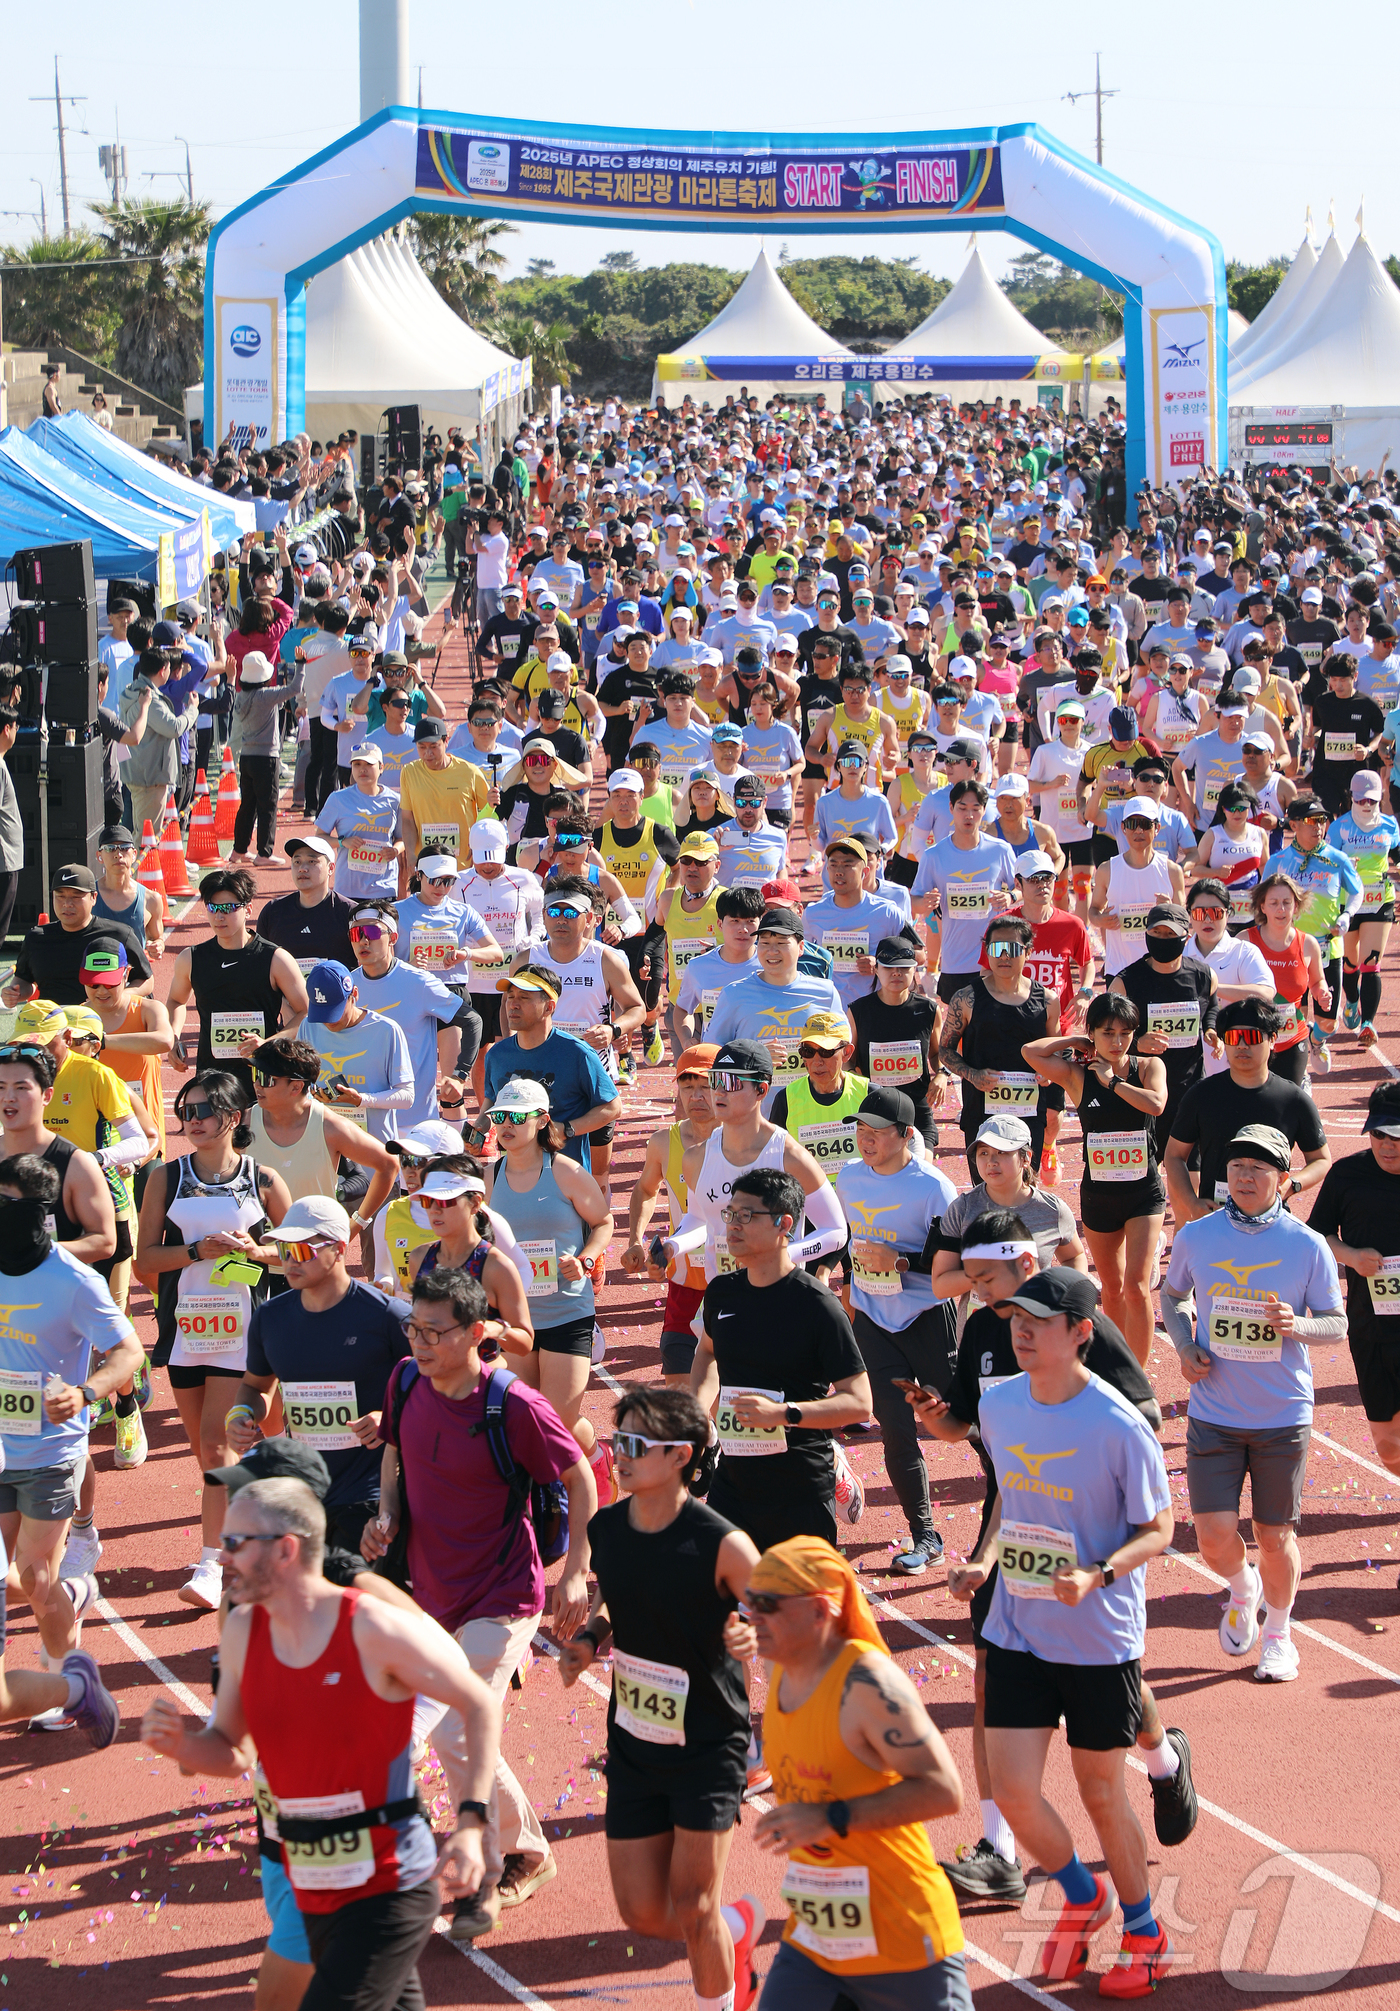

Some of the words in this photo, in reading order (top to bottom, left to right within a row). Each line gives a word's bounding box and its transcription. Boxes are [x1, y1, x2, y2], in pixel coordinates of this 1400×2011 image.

[521, 146, 574, 166] 2025년
[576, 151, 624, 169] APEC
[627, 155, 683, 172] 정상회의
[686, 158, 742, 175] 제주유치
[746, 160, 777, 175] 기원!
[519, 164, 553, 181] 제28회
[533, 183, 552, 194] 1995
[554, 169, 673, 204] 제주국제관광
[678, 175, 777, 208] 마라톤축제
[784, 162, 845, 207] START
[895, 159, 958, 204] FINISH
[795, 365, 843, 379] 오리온
[851, 365, 934, 379] 제주용암수
[1176, 391, 1206, 400] 오리온
[1275, 409, 1297, 417] HALF
[1170, 431, 1204, 440] LOTTE
[1173, 443, 1202, 454] DUTY
[1173, 453, 1203, 463] FREE
[307, 643, 327, 656] NIKE
[1326, 742, 1353, 751] 5783
[662, 754, 698, 764] MIZUNO
[747, 754, 781, 763] MIZUNO
[352, 822, 390, 834] MIZUNO
[424, 835, 456, 847] 5471
[351, 849, 384, 863] 6007
[1222, 846, 1258, 855] KOREA
[612, 862, 641, 871] 달리기
[734, 862, 776, 872] MIZUNO
[950, 895, 985, 907] 5251
[826, 945, 865, 959] 5149
[559, 976, 594, 988] 스트탑
[757, 1024, 803, 1038] MIZUN
[1152, 1018, 1196, 1032] 5347
[873, 1056, 919, 1072] 6064
[989, 1087, 1035, 1101] 5077
[805, 1137, 855, 1158] 5646
[1092, 1149, 1144, 1165] 6103
[851, 1220, 897, 1243] MIZUNO
[1206, 1282, 1279, 1301] MIZUNO
[178, 1315, 237, 1334] 6010
[1214, 1319, 1276, 1342] 5138
[291, 1406, 351, 1427] 5500
[1002, 1470, 1073, 1502] MIZUNO
[618, 1679, 678, 1722] 5143
